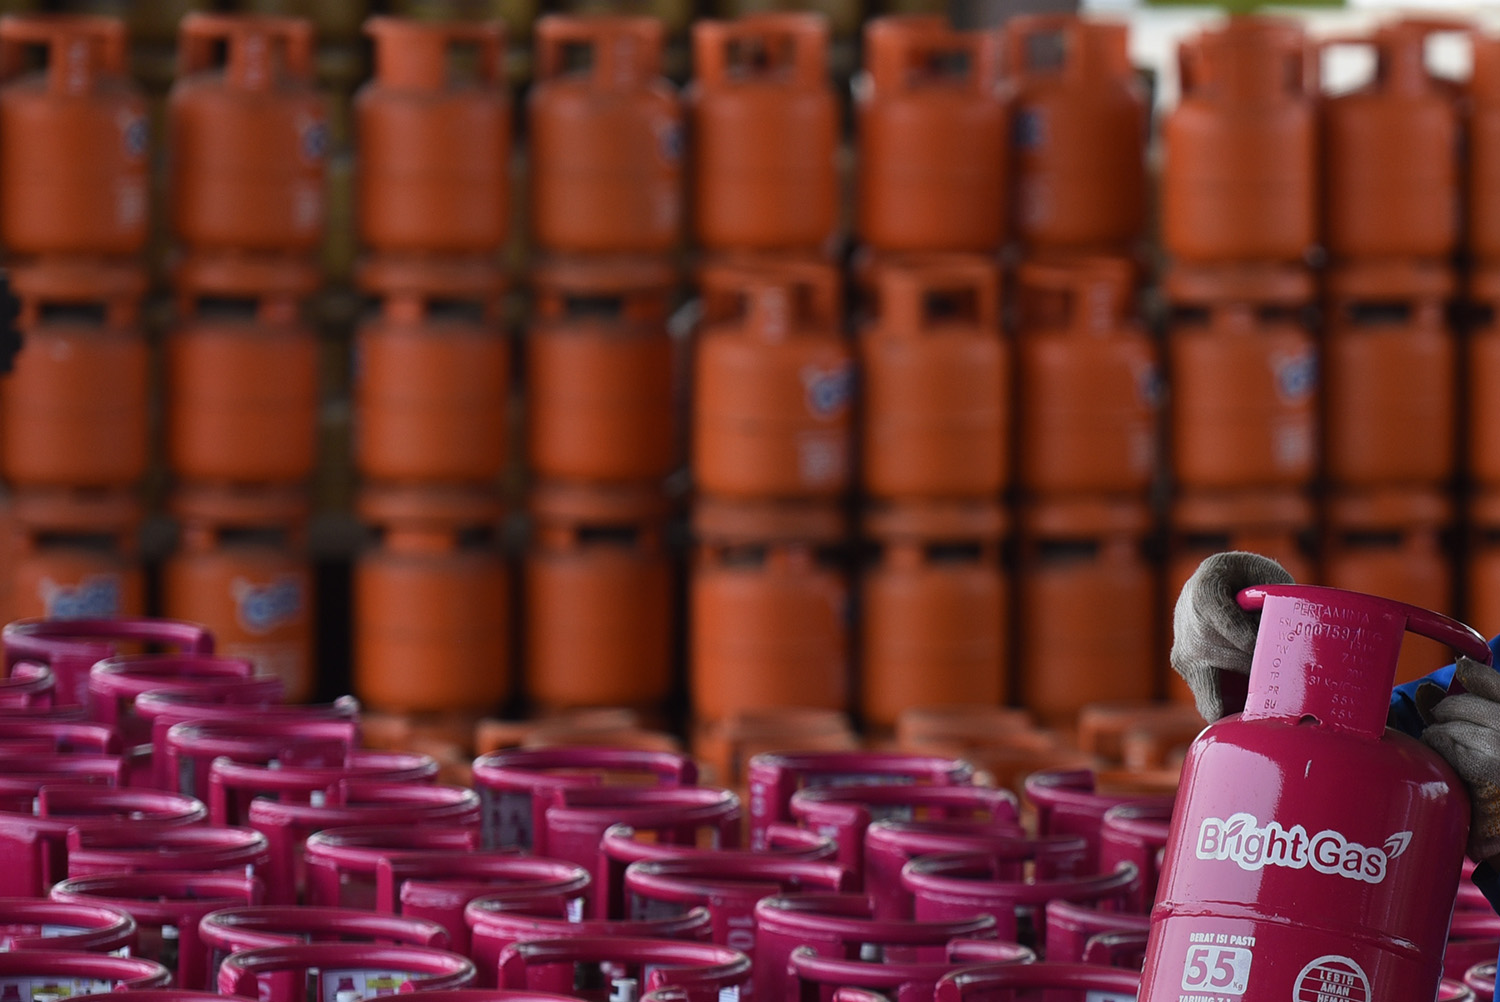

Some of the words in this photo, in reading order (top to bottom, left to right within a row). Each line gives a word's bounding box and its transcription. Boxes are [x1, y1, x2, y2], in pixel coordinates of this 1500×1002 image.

[1198, 817, 1306, 867] Bright
[1311, 834, 1384, 880] Gas
[1189, 932, 1215, 943] BERAT
[1216, 934, 1228, 944] ISI
[1229, 935, 1256, 947] PASTI
[1232, 981, 1244, 991] Kg
[1320, 970, 1354, 986] LEBIH
[1320, 981, 1350, 997] AMAN
